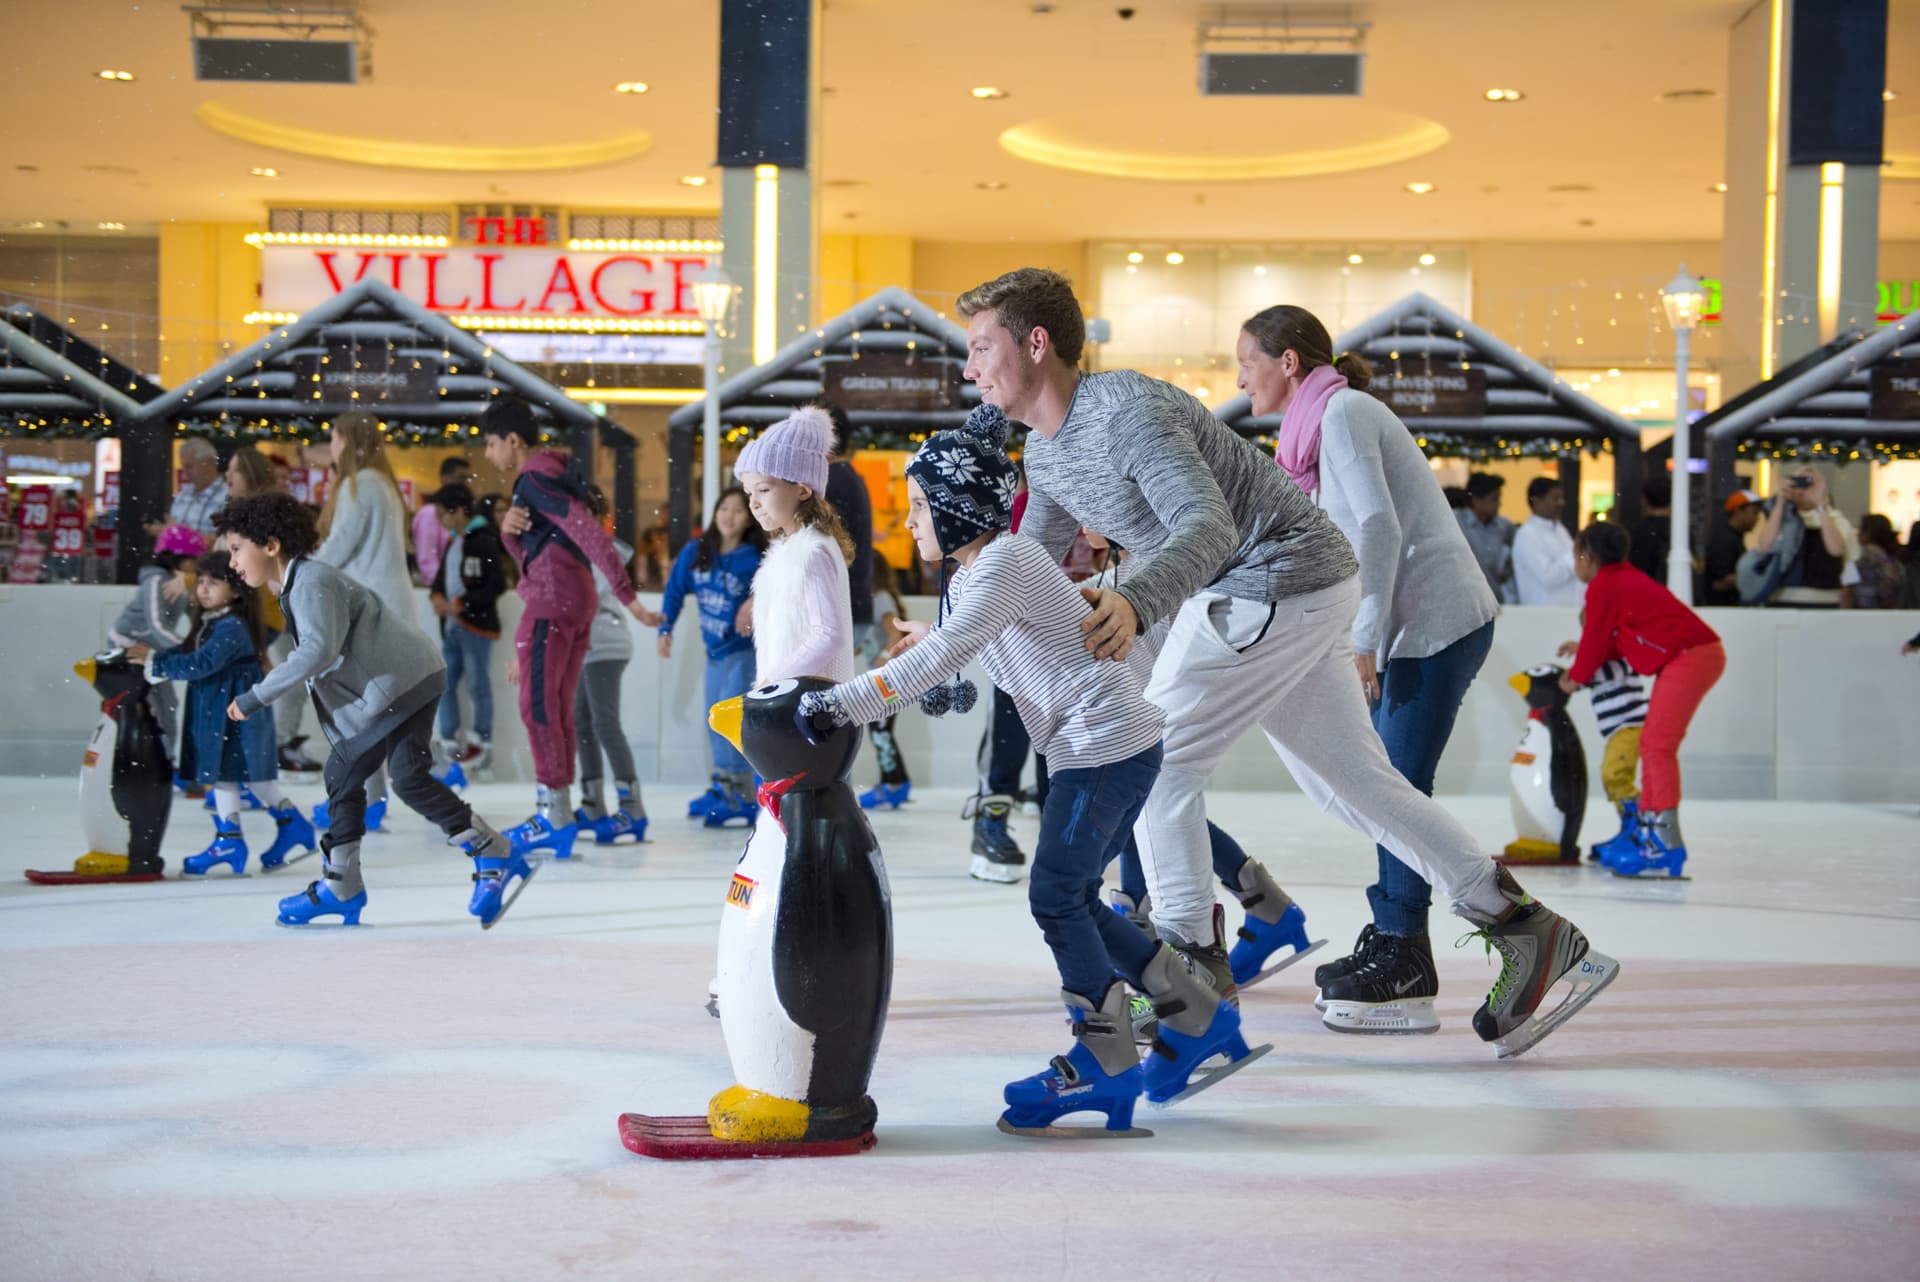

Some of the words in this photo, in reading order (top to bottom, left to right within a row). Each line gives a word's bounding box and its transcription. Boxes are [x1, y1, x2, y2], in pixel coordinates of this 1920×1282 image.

[466, 216, 549, 245] THE
[313, 251, 708, 316] VILLAGE
[842, 377, 888, 390] GREEN
[1392, 376, 1468, 391] INVENTING
[23, 503, 48, 525] 79
[53, 527, 81, 550] 39
[1581, 961, 1605, 977] DIR
